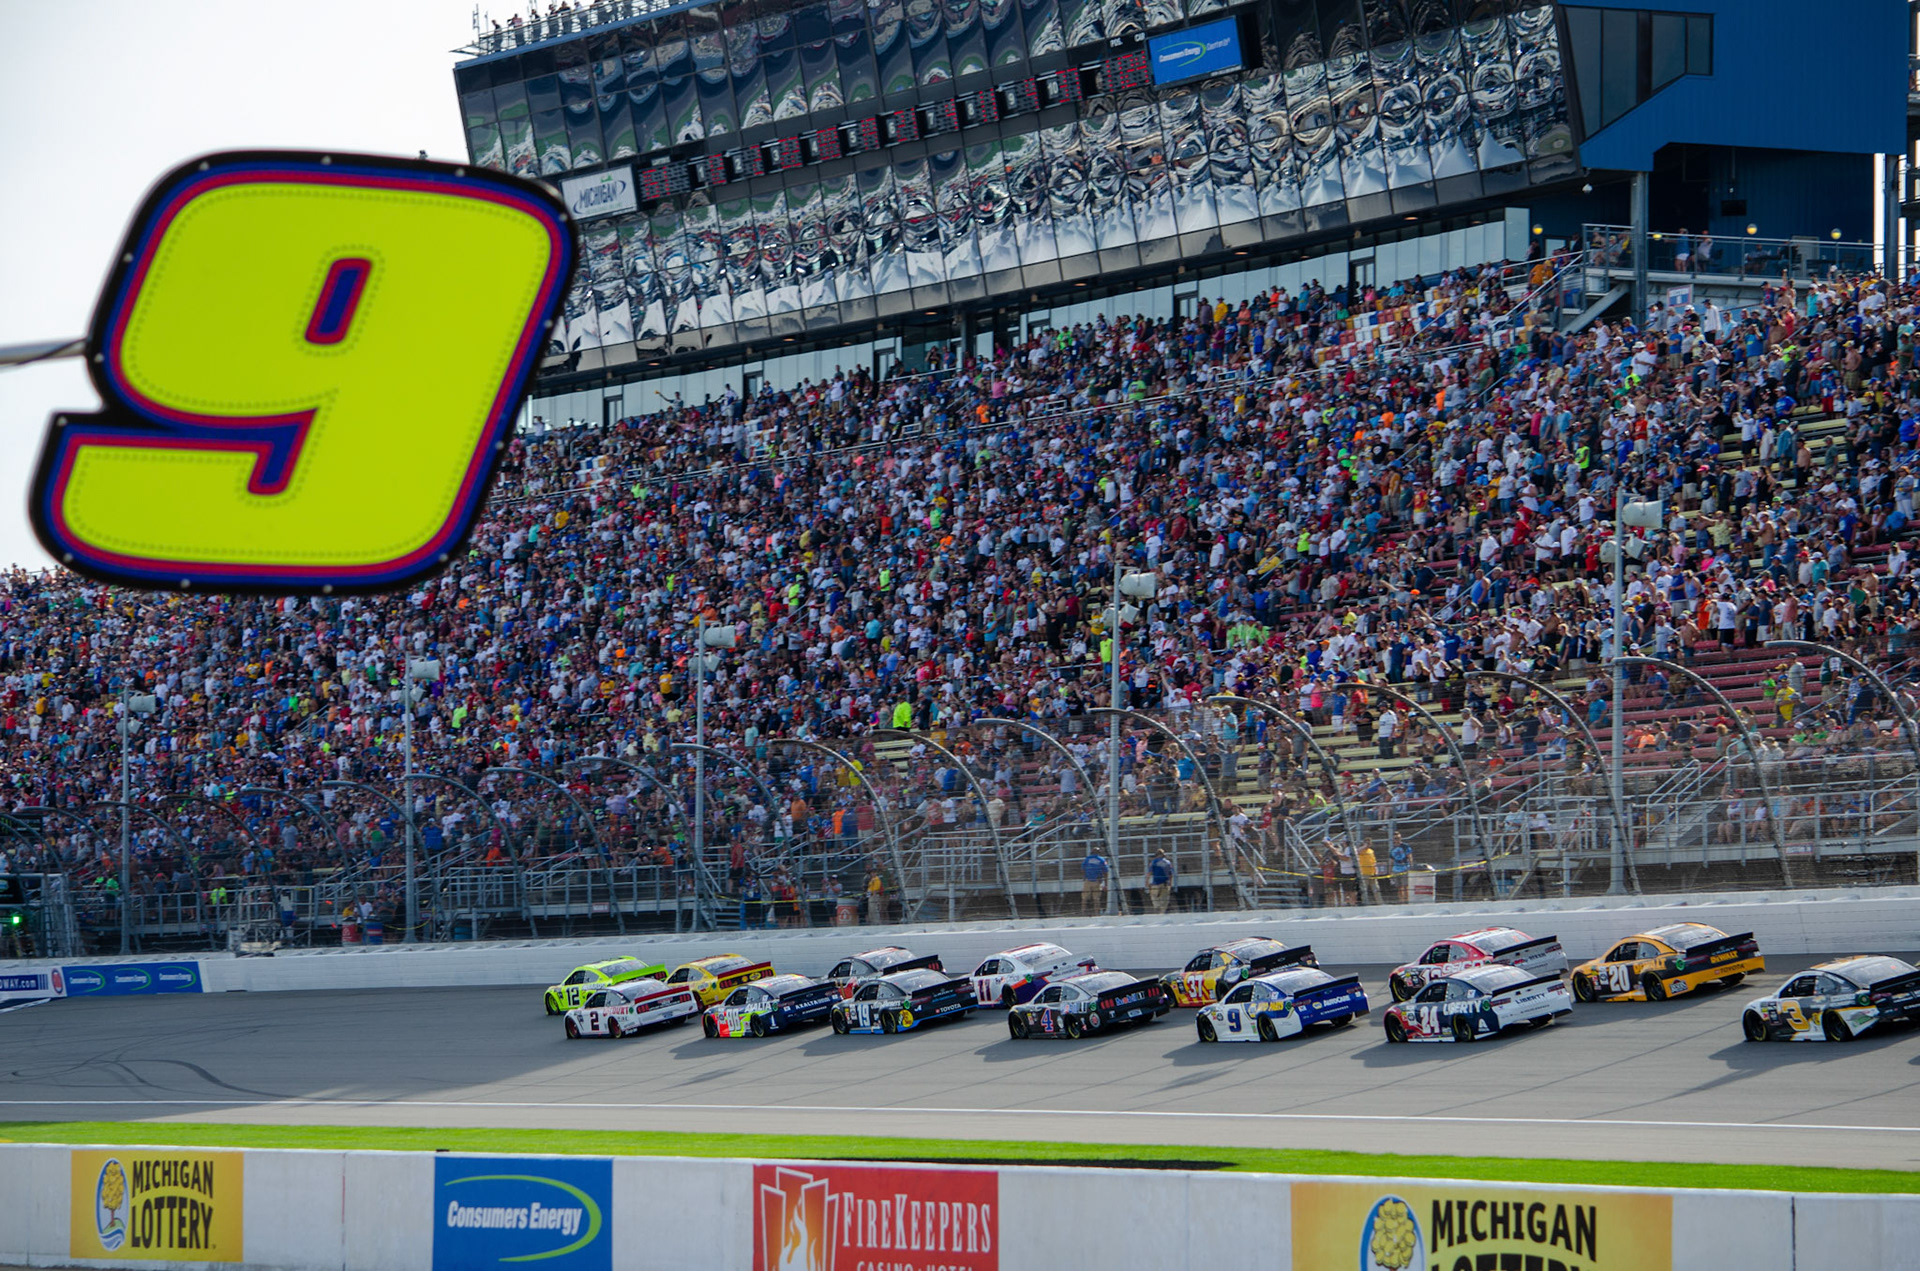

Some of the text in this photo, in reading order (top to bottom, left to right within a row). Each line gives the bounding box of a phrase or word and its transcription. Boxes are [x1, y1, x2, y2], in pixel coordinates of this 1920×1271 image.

[1047, 81, 1059, 95] 10
[967, 103, 975, 115] 8
[1007, 92, 1015, 106] 9
[888, 121, 896, 134] 6
[927, 112, 934, 126] 7
[810, 140, 818, 153] 4
[849, 130, 857, 143] 5
[735, 158, 742, 171] 2
[772, 149, 779, 162] 3
[697, 165, 705, 179] 1
[579, 181, 618, 209] MICHIGAN
[52, 173, 560, 574] 9
[1442, 959, 1484, 974] GEICO
[1720, 963, 1745, 973] TOYOTA
[1187, 974, 1203, 998] 37
[1608, 964, 1631, 992] 20
[565, 986, 580, 1006] 12
[977, 979, 992, 1002] 11
[1515, 992, 1546, 1004] LIBERTY
[795, 1000, 819, 1010] AXALTA
[939, 1003, 962, 1013] TOYOTA
[1443, 1000, 1482, 1016] LIBERTY
[1781, 999, 1810, 1031] 3
[589, 1010, 600, 1031] 2
[726, 1008, 742, 1031] 88
[856, 1003, 871, 1028] 19
[1040, 1007, 1054, 1033] 4
[1227, 1008, 1242, 1033] 9
[1419, 1005, 1441, 1034] 24
[132, 1160, 214, 1199] MICHIGAN
[131, 1196, 214, 1249] LOTTERY
[447, 1200, 583, 1235] Consumers Energy
[1431, 1200, 1597, 1263] MICHIGAN
